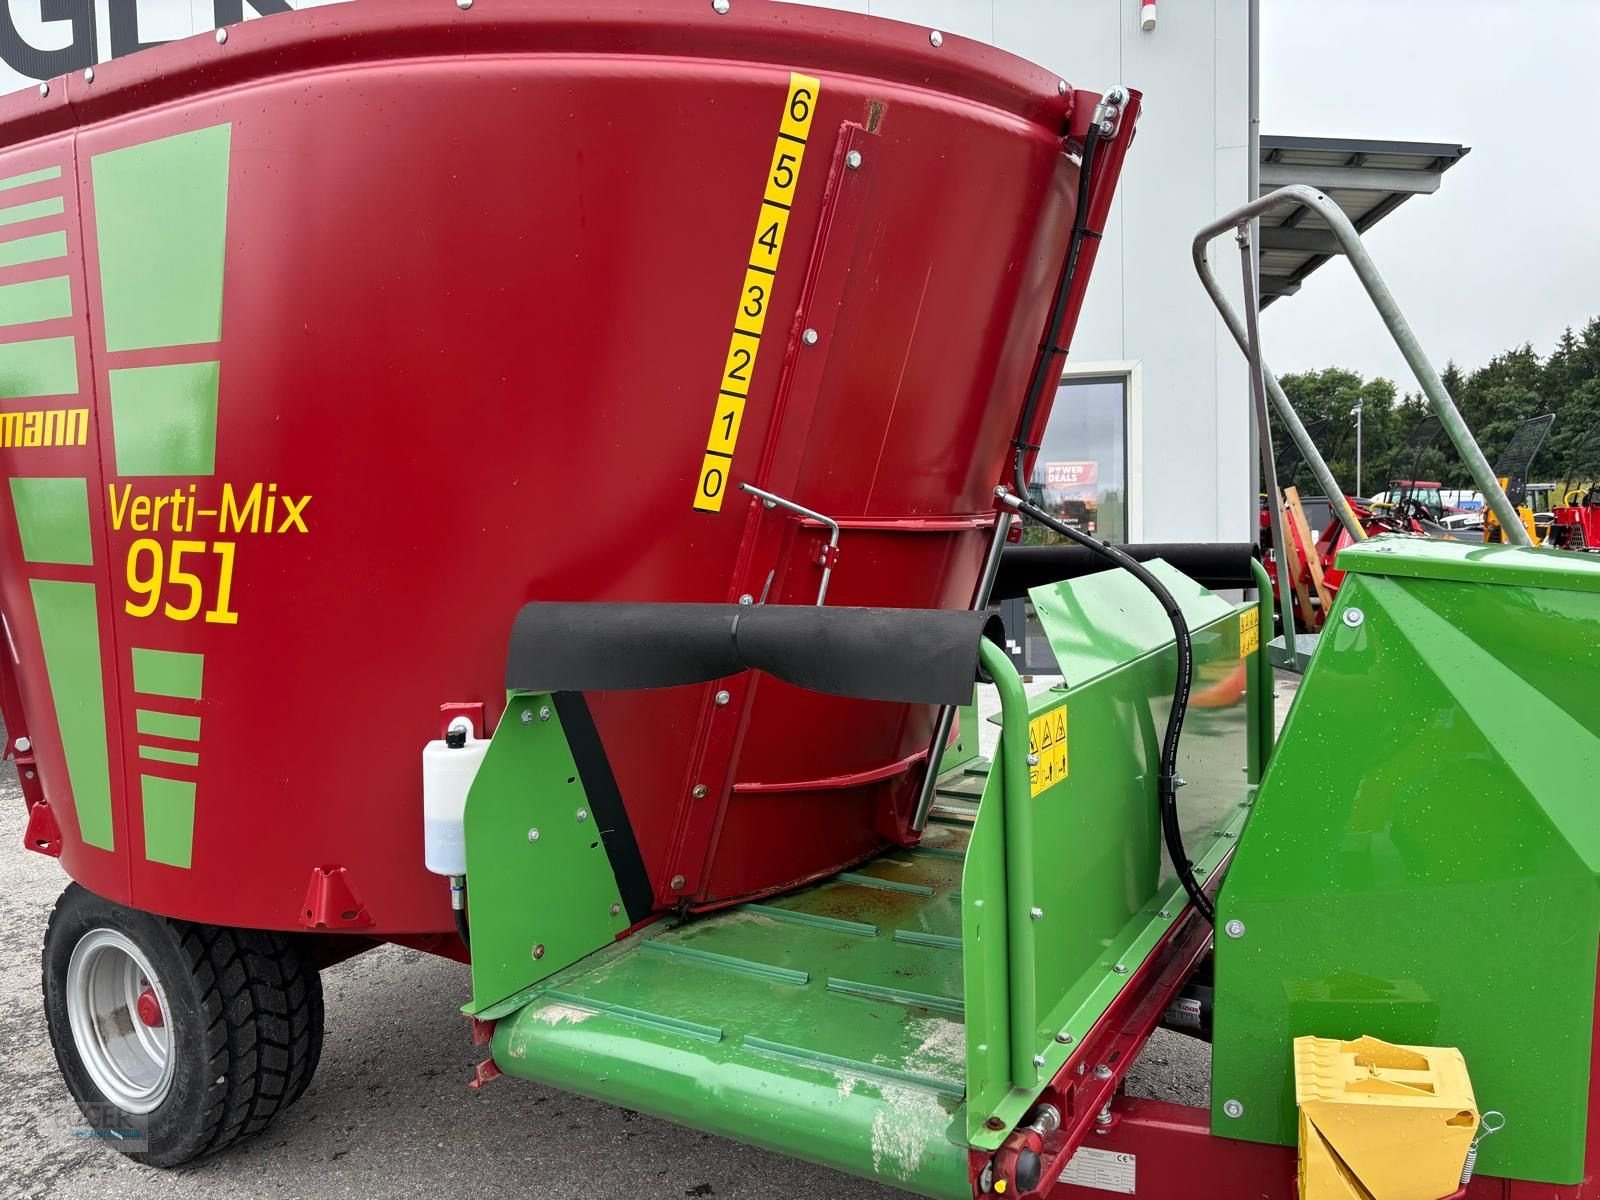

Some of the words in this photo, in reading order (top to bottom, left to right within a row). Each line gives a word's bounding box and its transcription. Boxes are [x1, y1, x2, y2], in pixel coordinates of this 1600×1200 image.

[790, 88, 811, 122] 6
[773, 153, 796, 188] 5
[758, 222, 779, 255] 4
[744, 285, 764, 317] 3
[727, 348, 751, 381] 2
[722, 411, 735, 441] 1
[703, 468, 722, 498] 0
[1048, 474, 1078, 483] DEALS
[108, 482, 313, 534] Verti-Mix
[125, 538, 239, 625] 951
